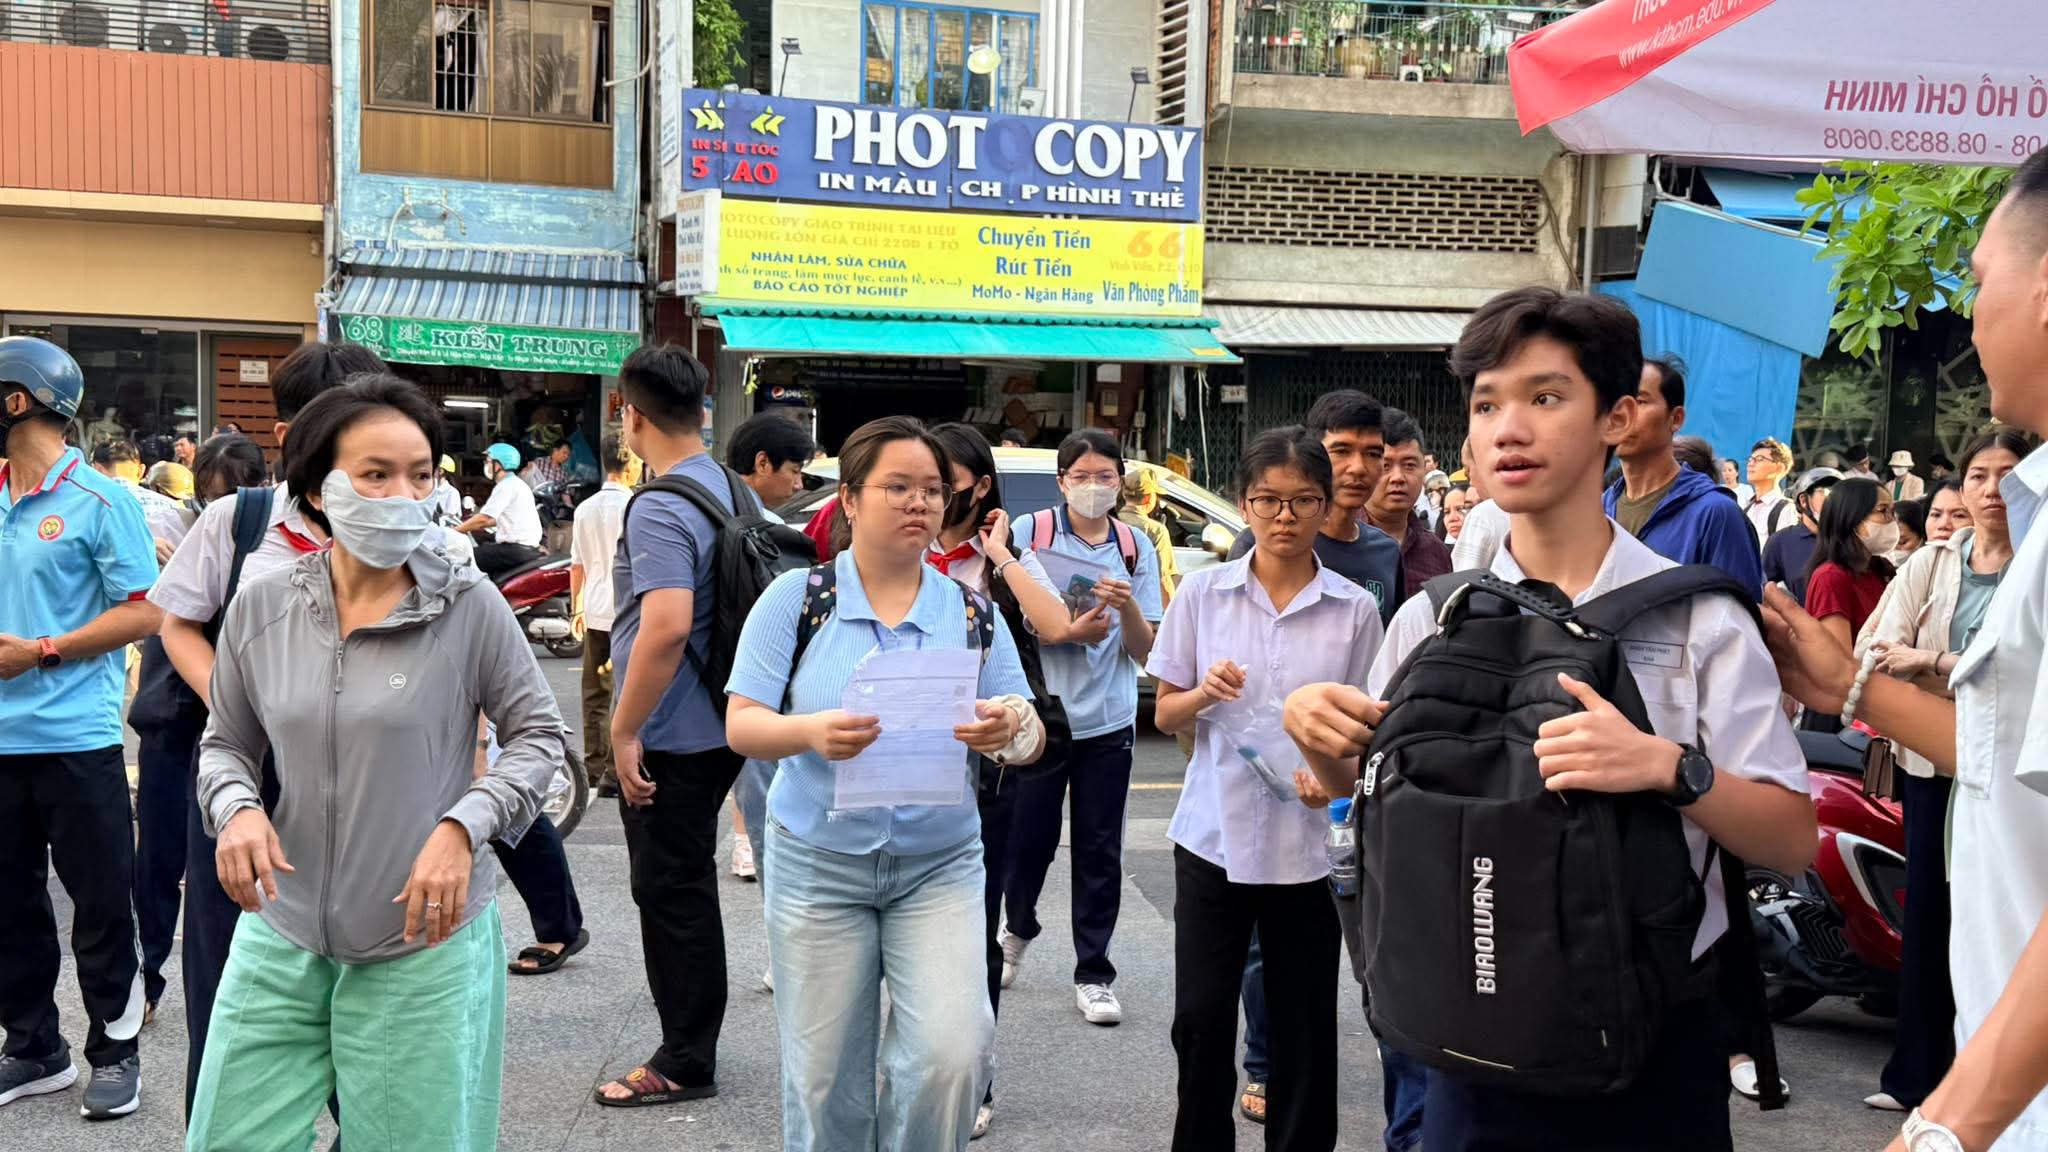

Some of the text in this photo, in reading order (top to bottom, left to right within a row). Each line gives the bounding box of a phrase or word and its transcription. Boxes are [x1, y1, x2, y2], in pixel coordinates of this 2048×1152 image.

[1617, 0, 1743, 69] www.kthcm.edu.v
[692, 139, 710, 150] IN
[1035, 122, 1197, 182] COPY
[692, 155, 710, 178] 5
[819, 172, 855, 190] IN
[864, 171, 937, 195] MÀU
[1047, 181, 1121, 204] HÌNH
[1131, 186, 1185, 208] THẺ
[978, 226, 1046, 250] Chuyển
[995, 256, 1028, 275] Rút
[972, 285, 1012, 299] MoMo
[1025, 286, 1057, 304] Ngân
[1062, 287, 1093, 304] Hàng
[347, 315, 384, 341] 68
[511, 334, 608, 359] TRUNG
[1472, 856, 1497, 995] BIAOWANG
